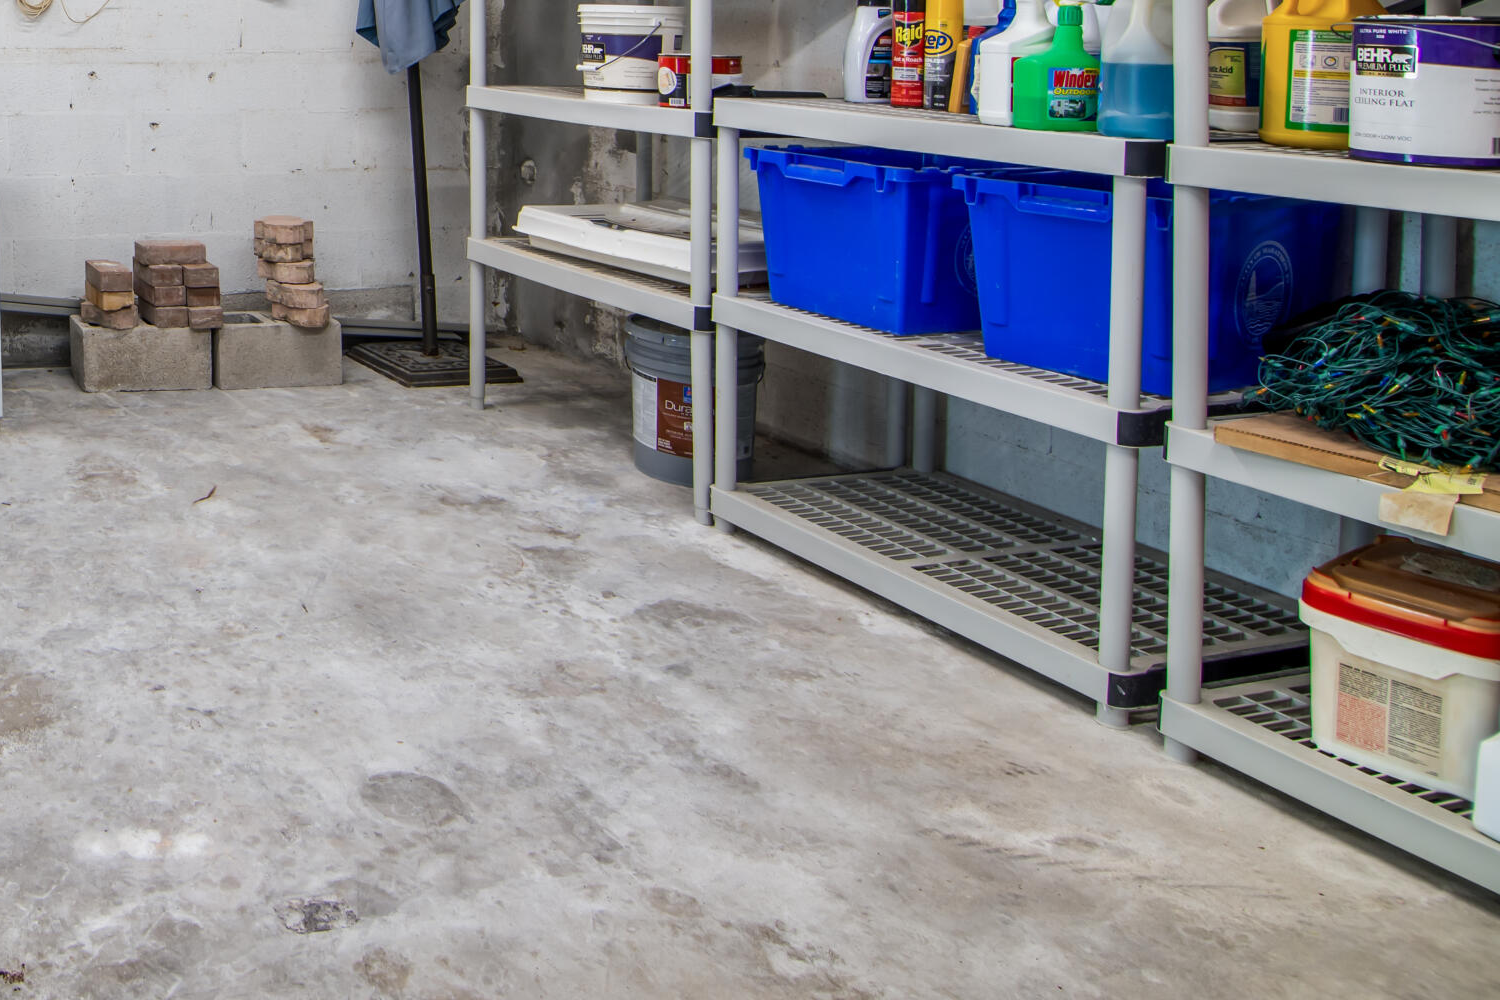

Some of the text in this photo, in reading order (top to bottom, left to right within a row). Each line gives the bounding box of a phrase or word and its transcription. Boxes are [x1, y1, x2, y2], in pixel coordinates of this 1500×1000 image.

[895, 23, 924, 47] Raid
[581, 44, 594, 54] EHR
[1357, 47, 1391, 62] BEHR
[1358, 62, 1411, 72] PREMIUM PLUS
[1053, 69, 1097, 88] Windex
[1359, 87, 1405, 98] INTERIOR
[1354, 96, 1415, 108] CEILING FLAT
